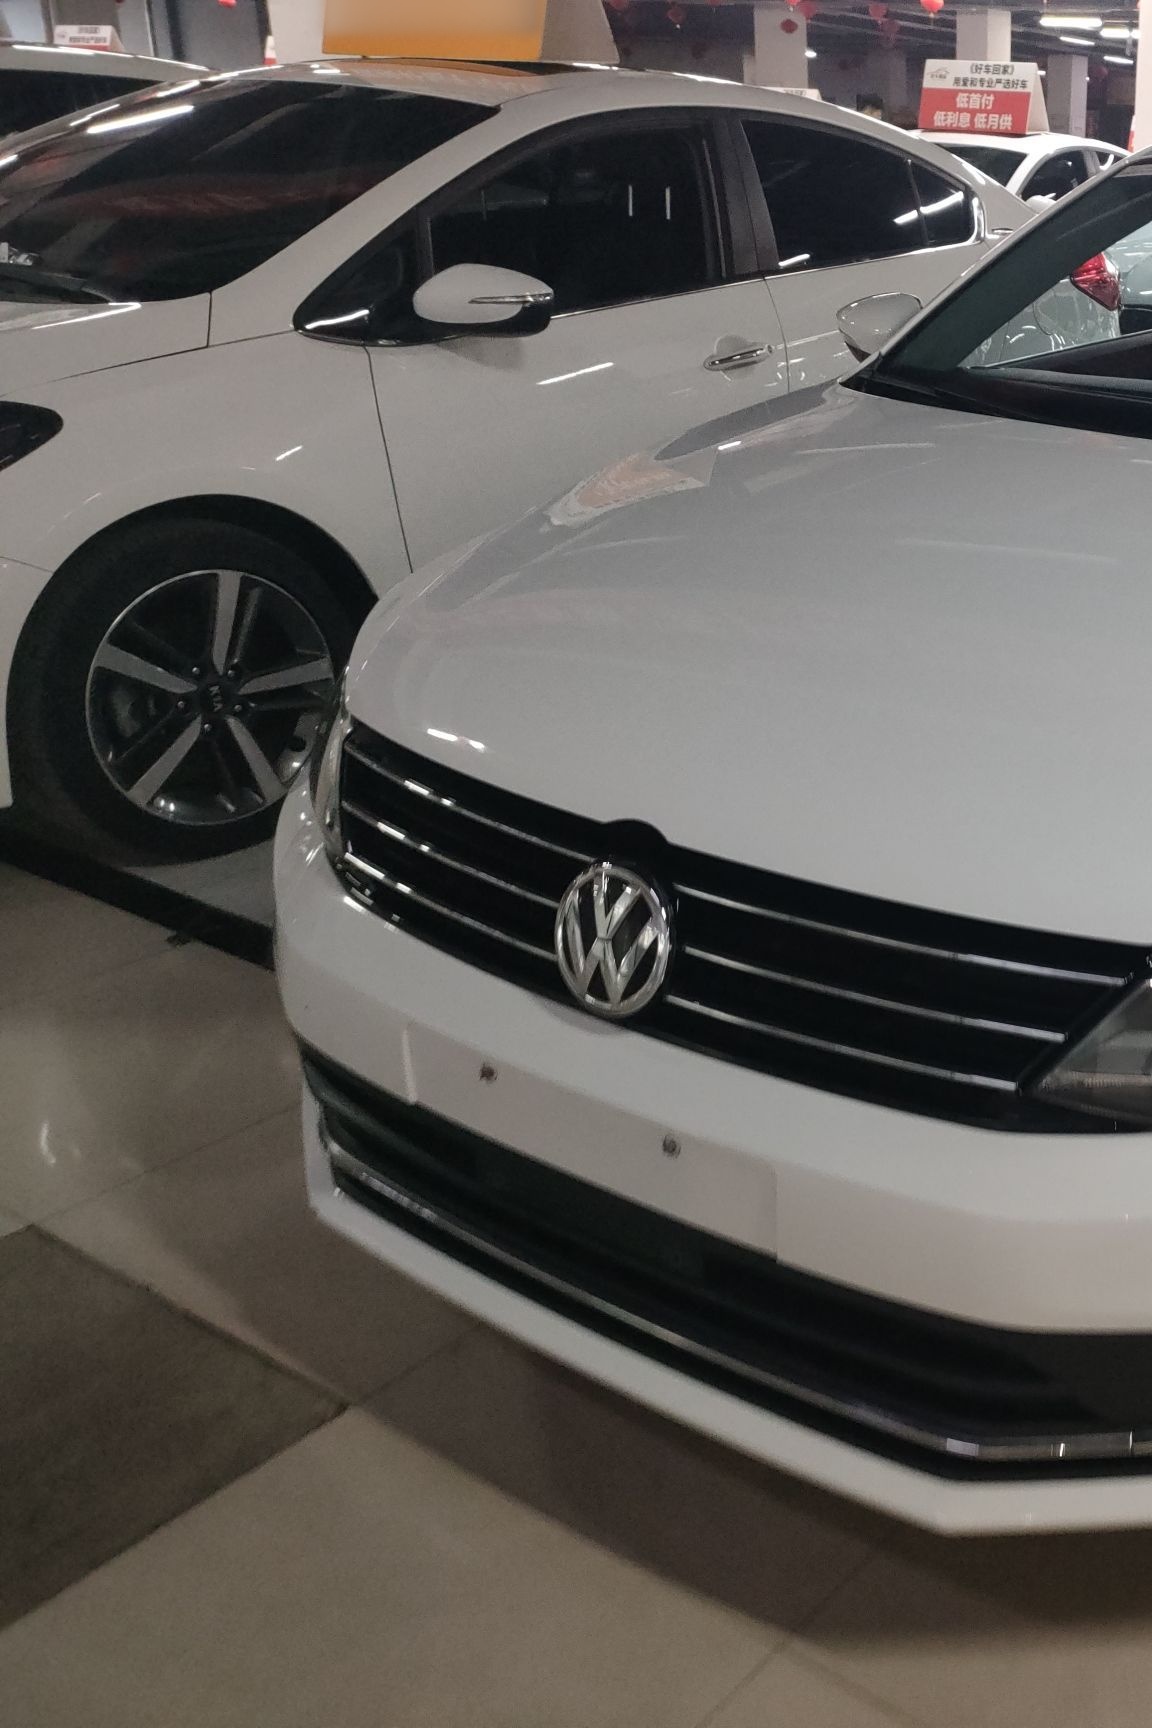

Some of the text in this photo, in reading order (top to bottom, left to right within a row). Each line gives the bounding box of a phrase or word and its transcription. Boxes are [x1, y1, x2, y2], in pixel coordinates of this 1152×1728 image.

[956, 92, 995, 110] 低首付
[934, 111, 1013, 130] 低利息 低月供
